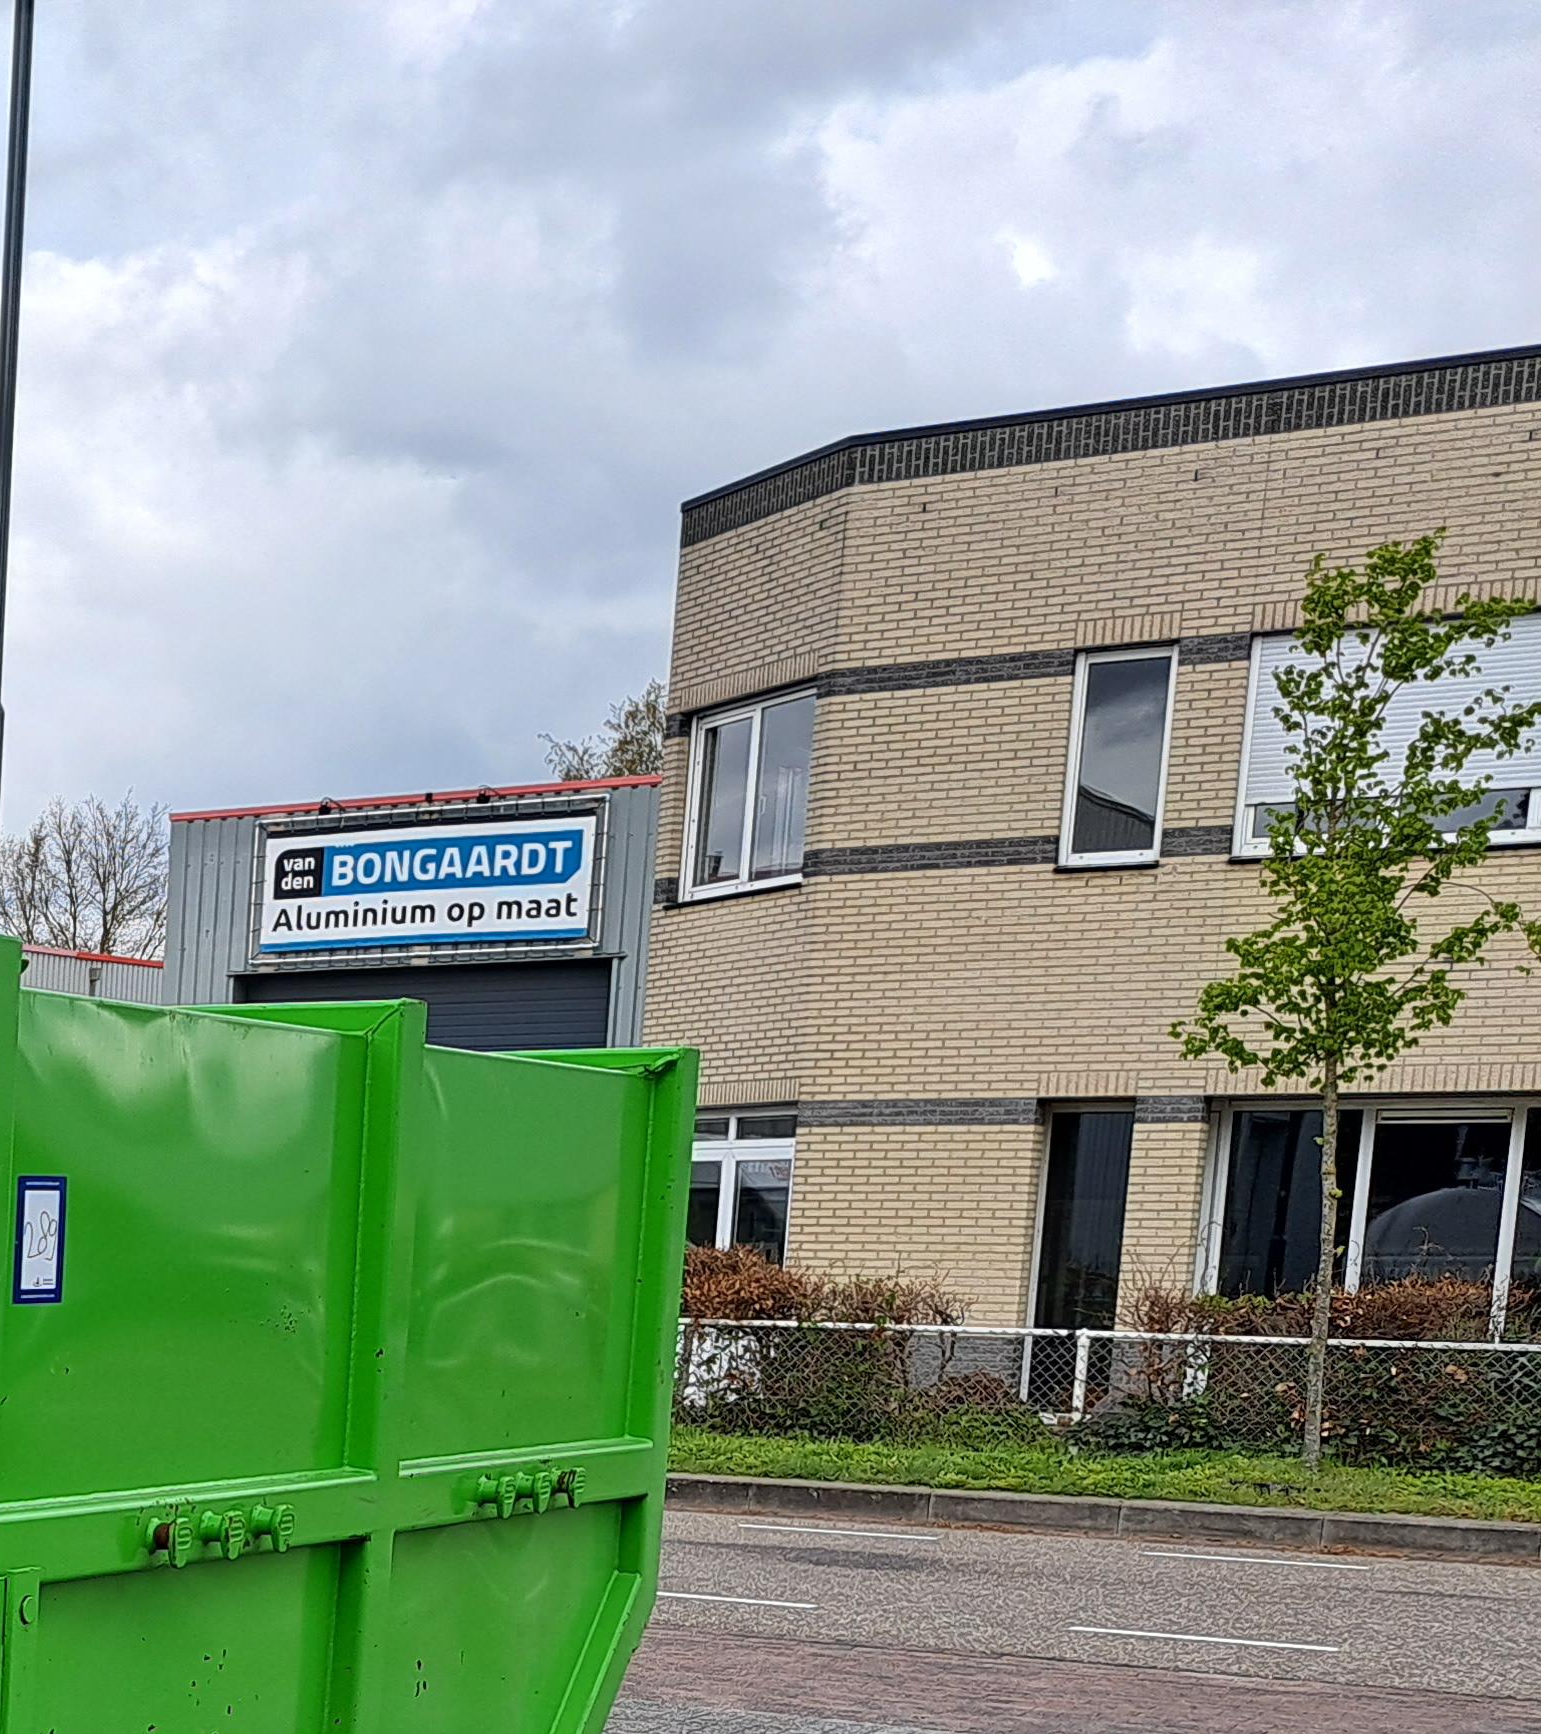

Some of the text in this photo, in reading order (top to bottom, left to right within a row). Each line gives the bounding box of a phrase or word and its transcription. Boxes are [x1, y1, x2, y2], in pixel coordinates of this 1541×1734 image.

[283, 856, 315, 872] van
[331, 841, 573, 887] BONGAARDT
[281, 873, 314, 890] den
[272, 893, 578, 932] Aluminium op maat
